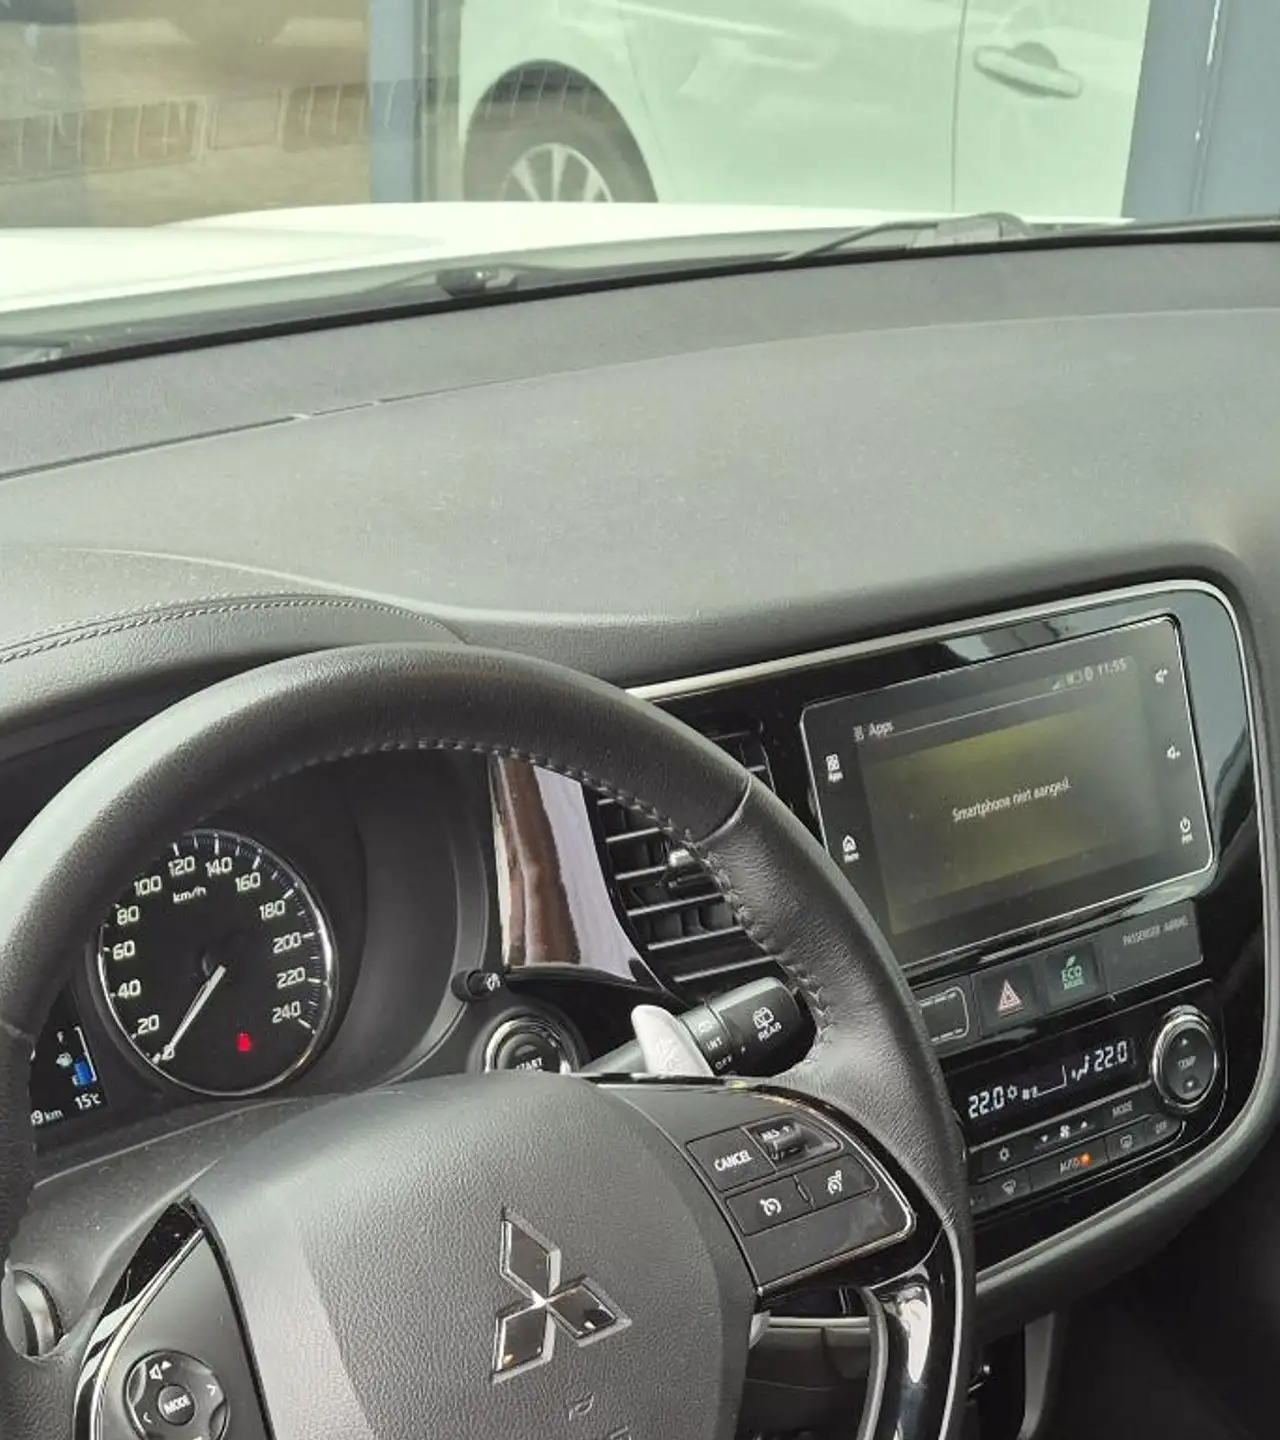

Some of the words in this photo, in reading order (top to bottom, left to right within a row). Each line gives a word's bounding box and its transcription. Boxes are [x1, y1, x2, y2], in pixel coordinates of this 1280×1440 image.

[168, 855, 196, 878] 120
[205, 856, 232, 878] 140
[133, 875, 163, 897] 100
[235, 871, 262, 893] 160
[172, 885, 207, 905] km/h
[116, 905, 139, 926] 80
[259, 899, 286, 921] 180
[112, 939, 136, 961] 60
[272, 931, 302, 955] 200
[117, 978, 141, 999] 40
[276, 966, 306, 990] 220
[271, 1000, 302, 1024] 240
[137, 1013, 161, 1035] 20
[1093, 1040, 1128, 1073] 22.0
[968, 1085, 1005, 1119] 22.0
[714, 1149, 753, 1172] CANCEL
[163, 1393, 192, 1415] MODE
